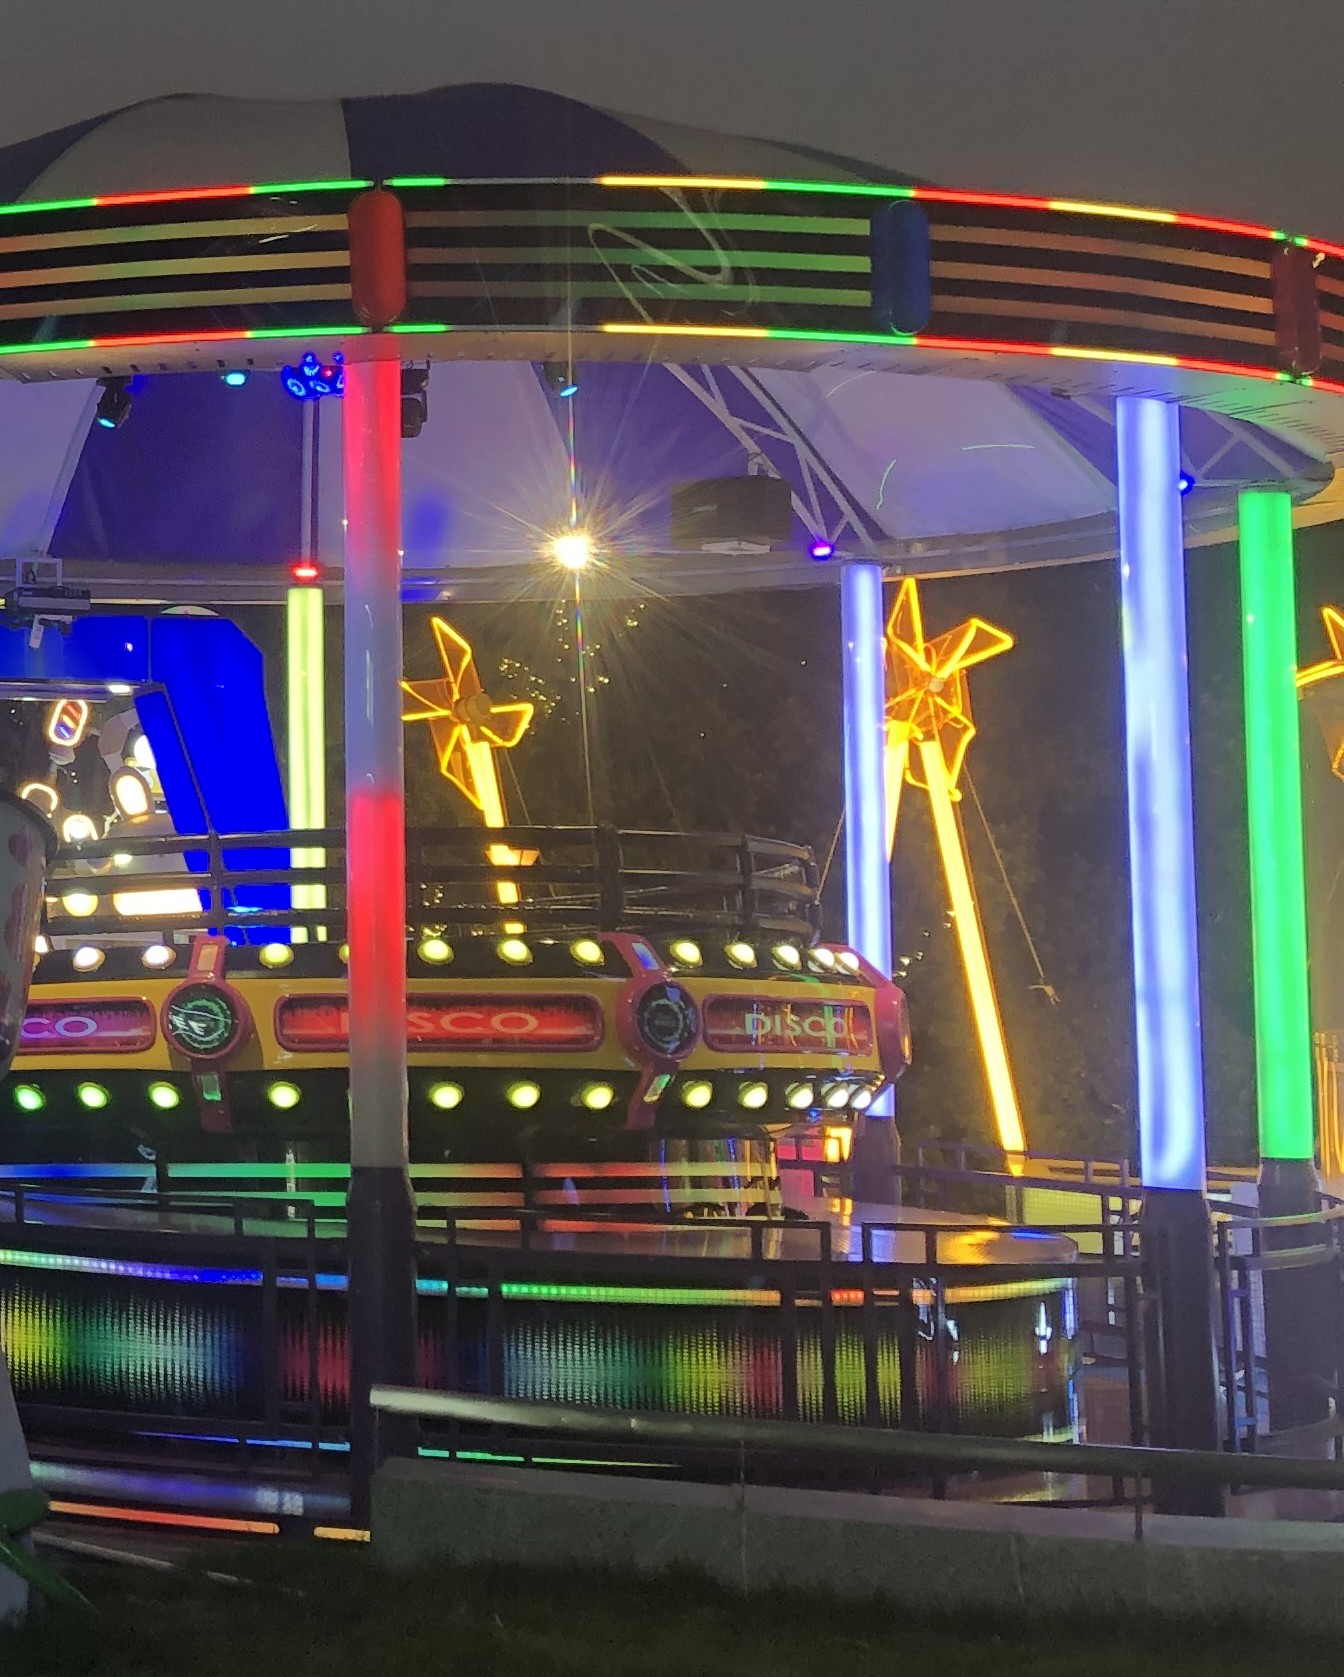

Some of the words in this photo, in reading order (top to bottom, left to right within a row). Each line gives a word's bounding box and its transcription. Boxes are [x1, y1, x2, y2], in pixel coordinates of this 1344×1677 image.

[20, 1015, 98, 1039] CO
[340, 1011, 539, 1035] SCO
[744, 1012, 847, 1038] DISCO
